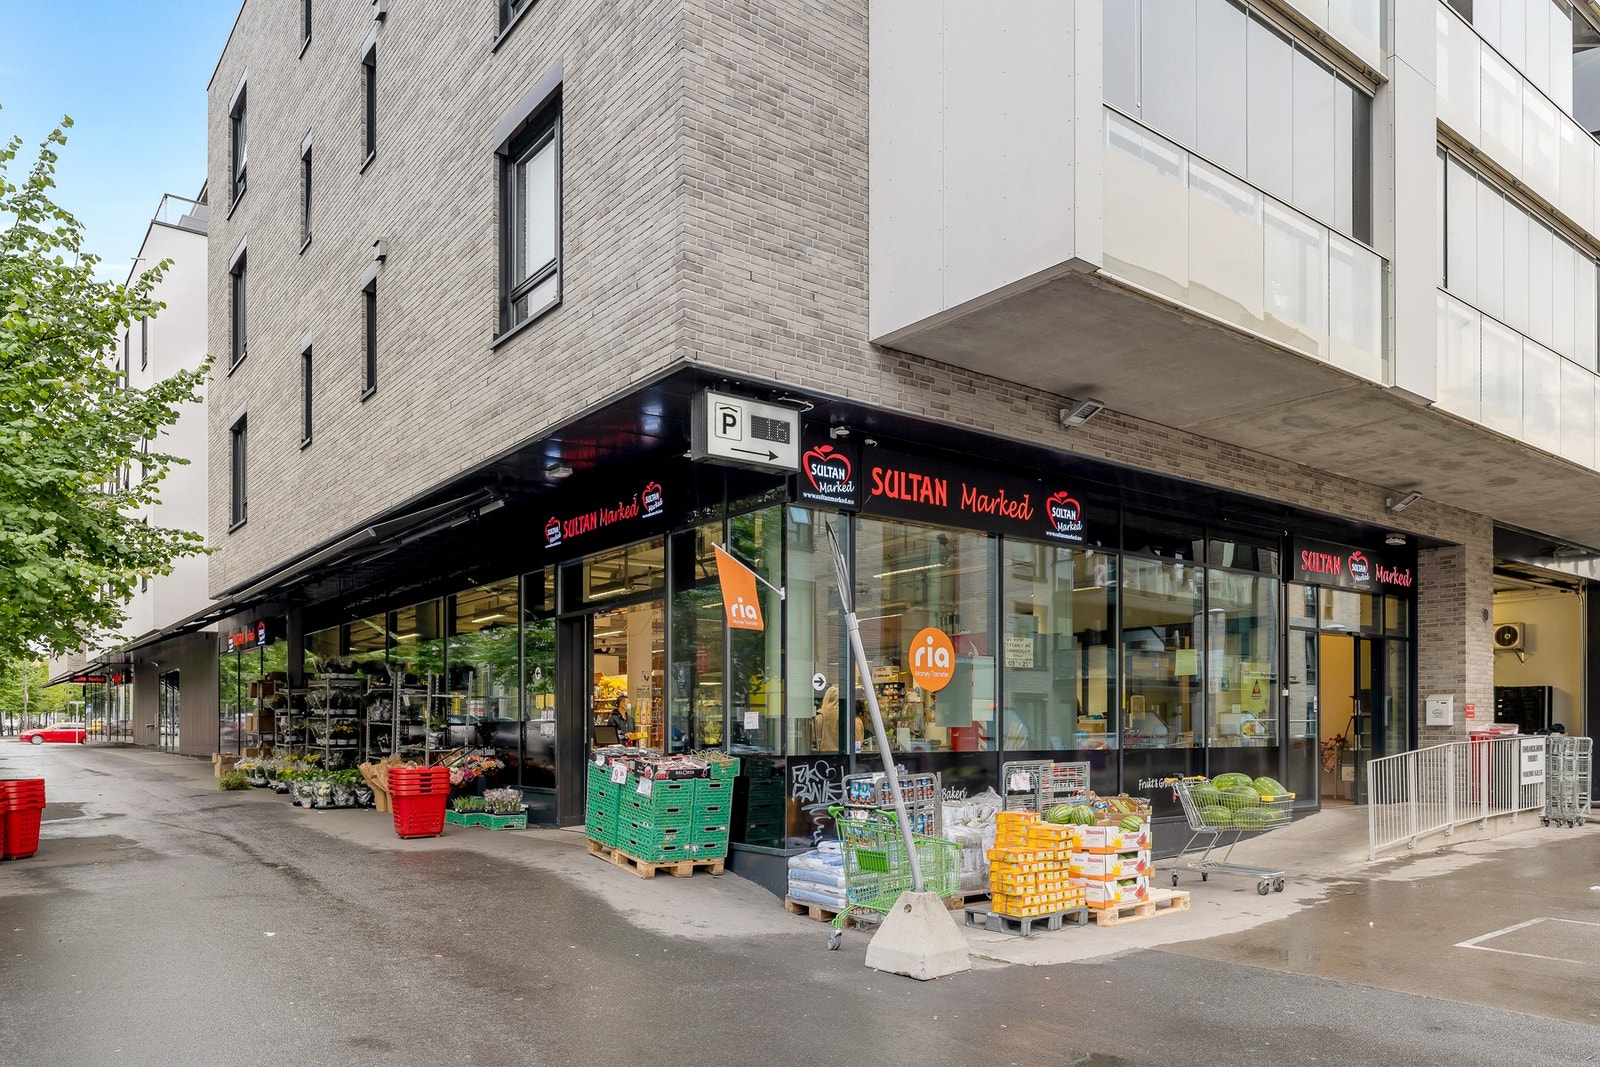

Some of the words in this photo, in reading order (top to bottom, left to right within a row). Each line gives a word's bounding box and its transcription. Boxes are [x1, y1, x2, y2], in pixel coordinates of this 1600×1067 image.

[722, 412, 737, 435] P
[766, 418, 787, 442] 16
[811, 463, 846, 480] SULTAN
[819, 481, 855, 493] Marked
[871, 466, 948, 507] SULTAN
[960, 482, 1034, 521] Marked
[562, 511, 598, 540] SULTAN
[599, 496, 640, 527] Marked
[1051, 506, 1077, 521] SULTAN
[1301, 549, 1341, 575] SULTAN
[1375, 563, 1412, 587] Marked
[731, 596, 758, 619] ria
[915, 635, 950, 668] ria
[915, 670, 931, 679] Money
[931, 670, 949, 678] Transfer
